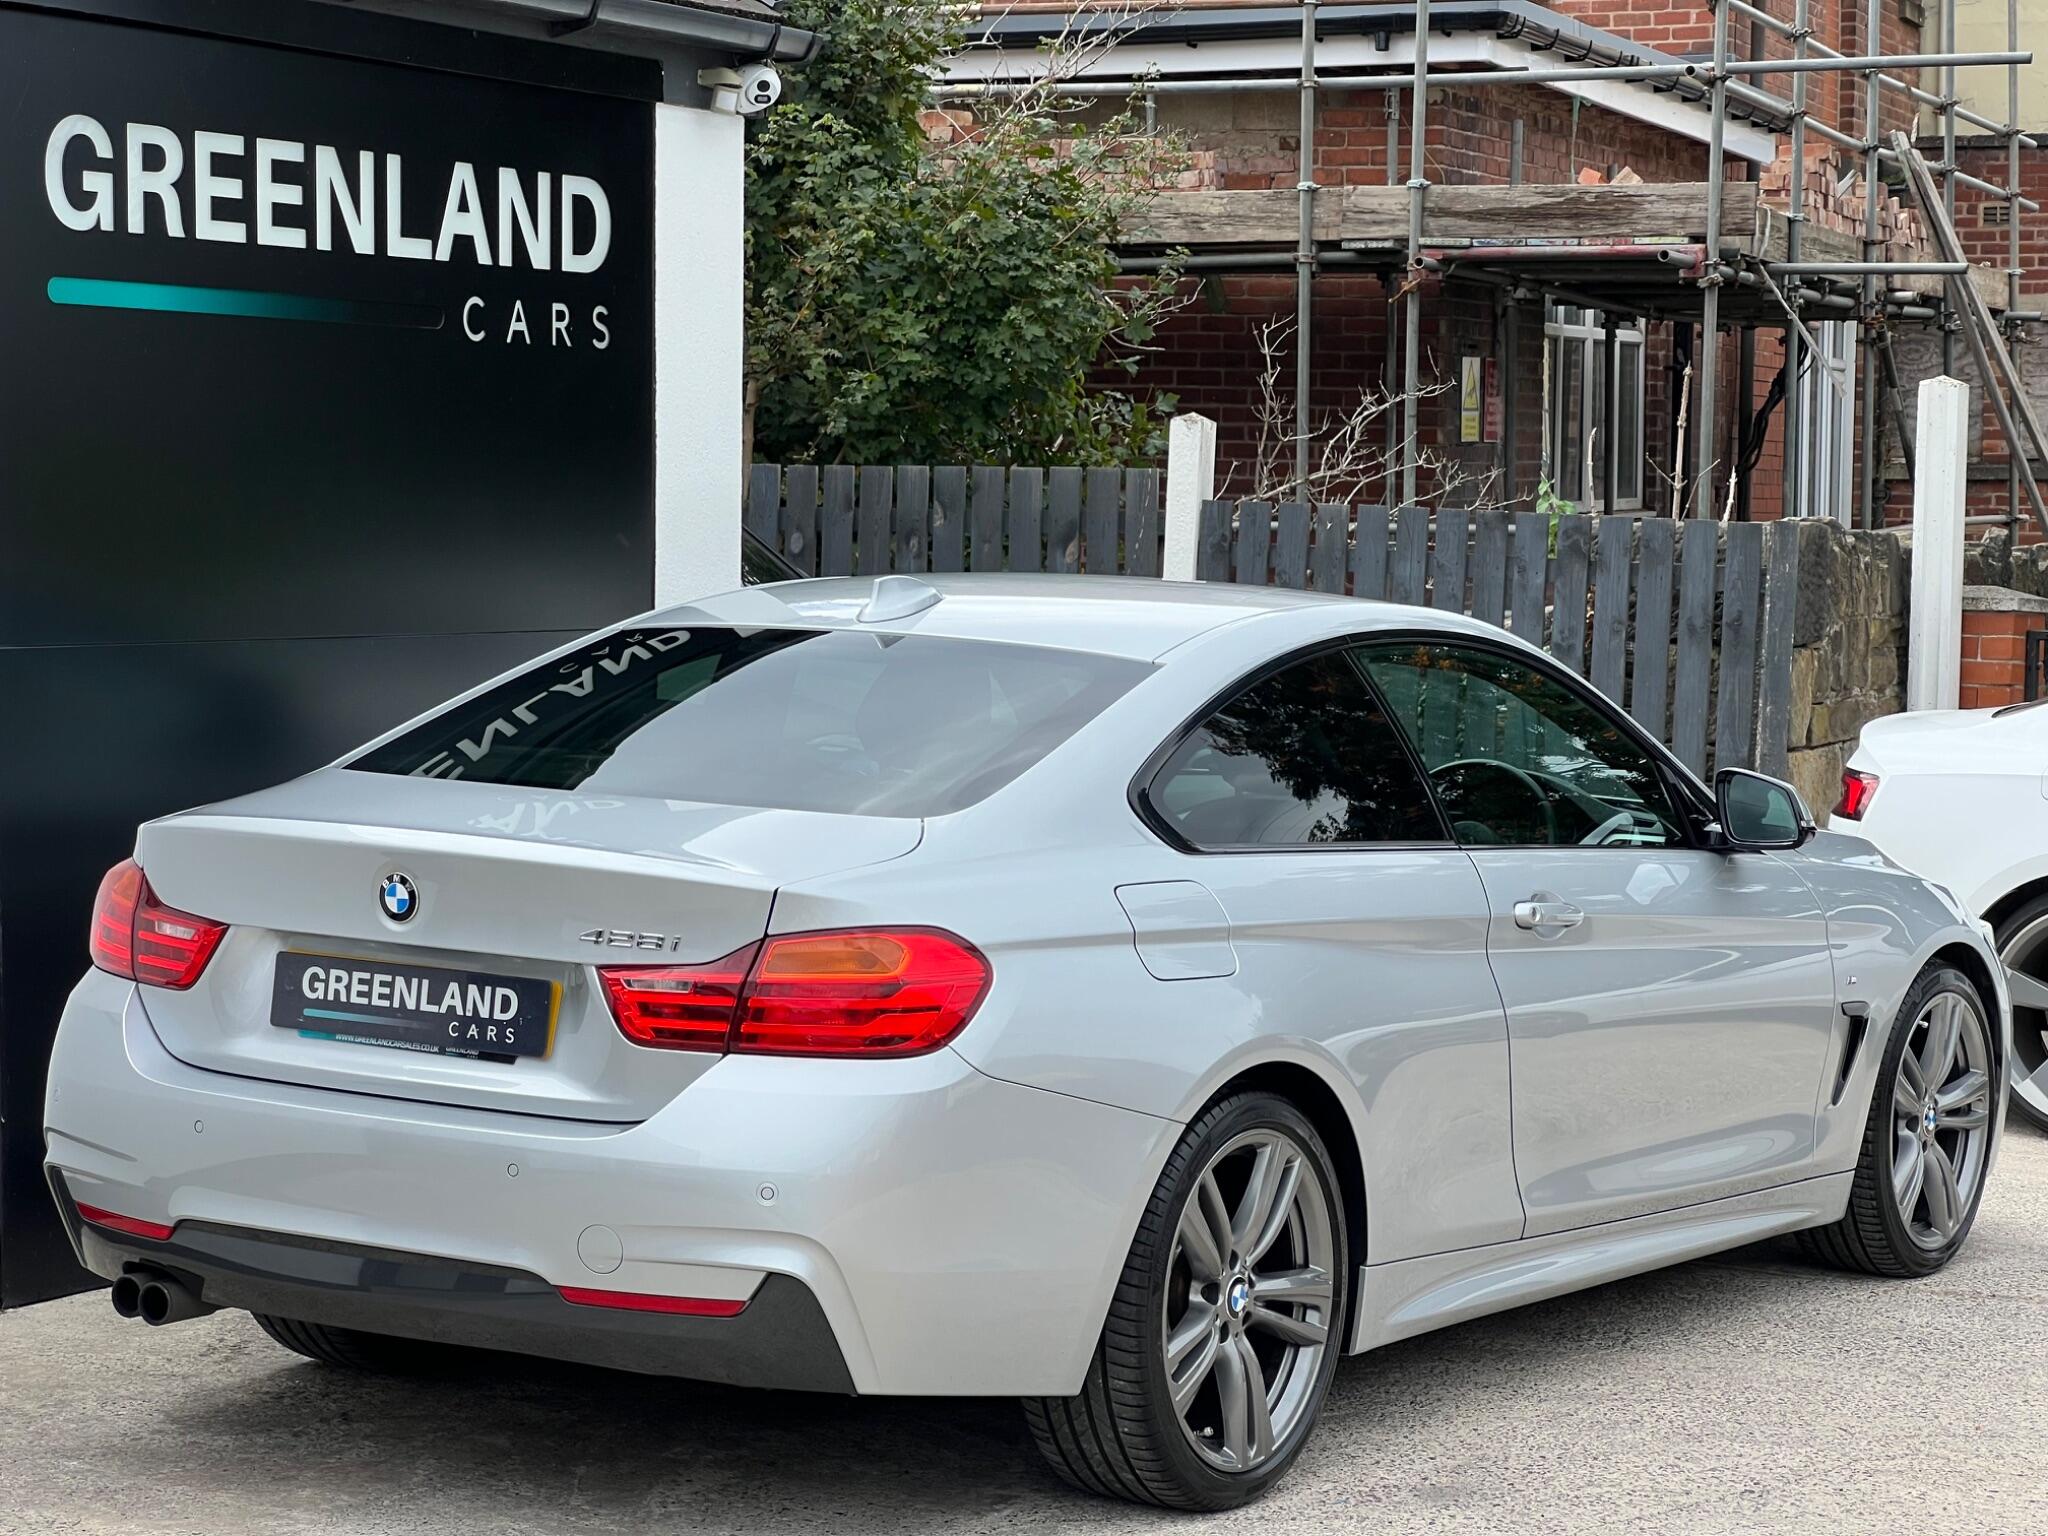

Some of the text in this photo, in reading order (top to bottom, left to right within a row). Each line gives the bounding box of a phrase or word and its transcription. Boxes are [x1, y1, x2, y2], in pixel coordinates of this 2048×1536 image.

[44, 113, 612, 274] GREENLAND
[462, 296, 611, 350] CARS
[382, 873, 415, 891] BMW
[579, 928, 681, 952] 428i
[302, 966, 519, 1021] GREENLAND
[448, 1021, 515, 1043] CARS
